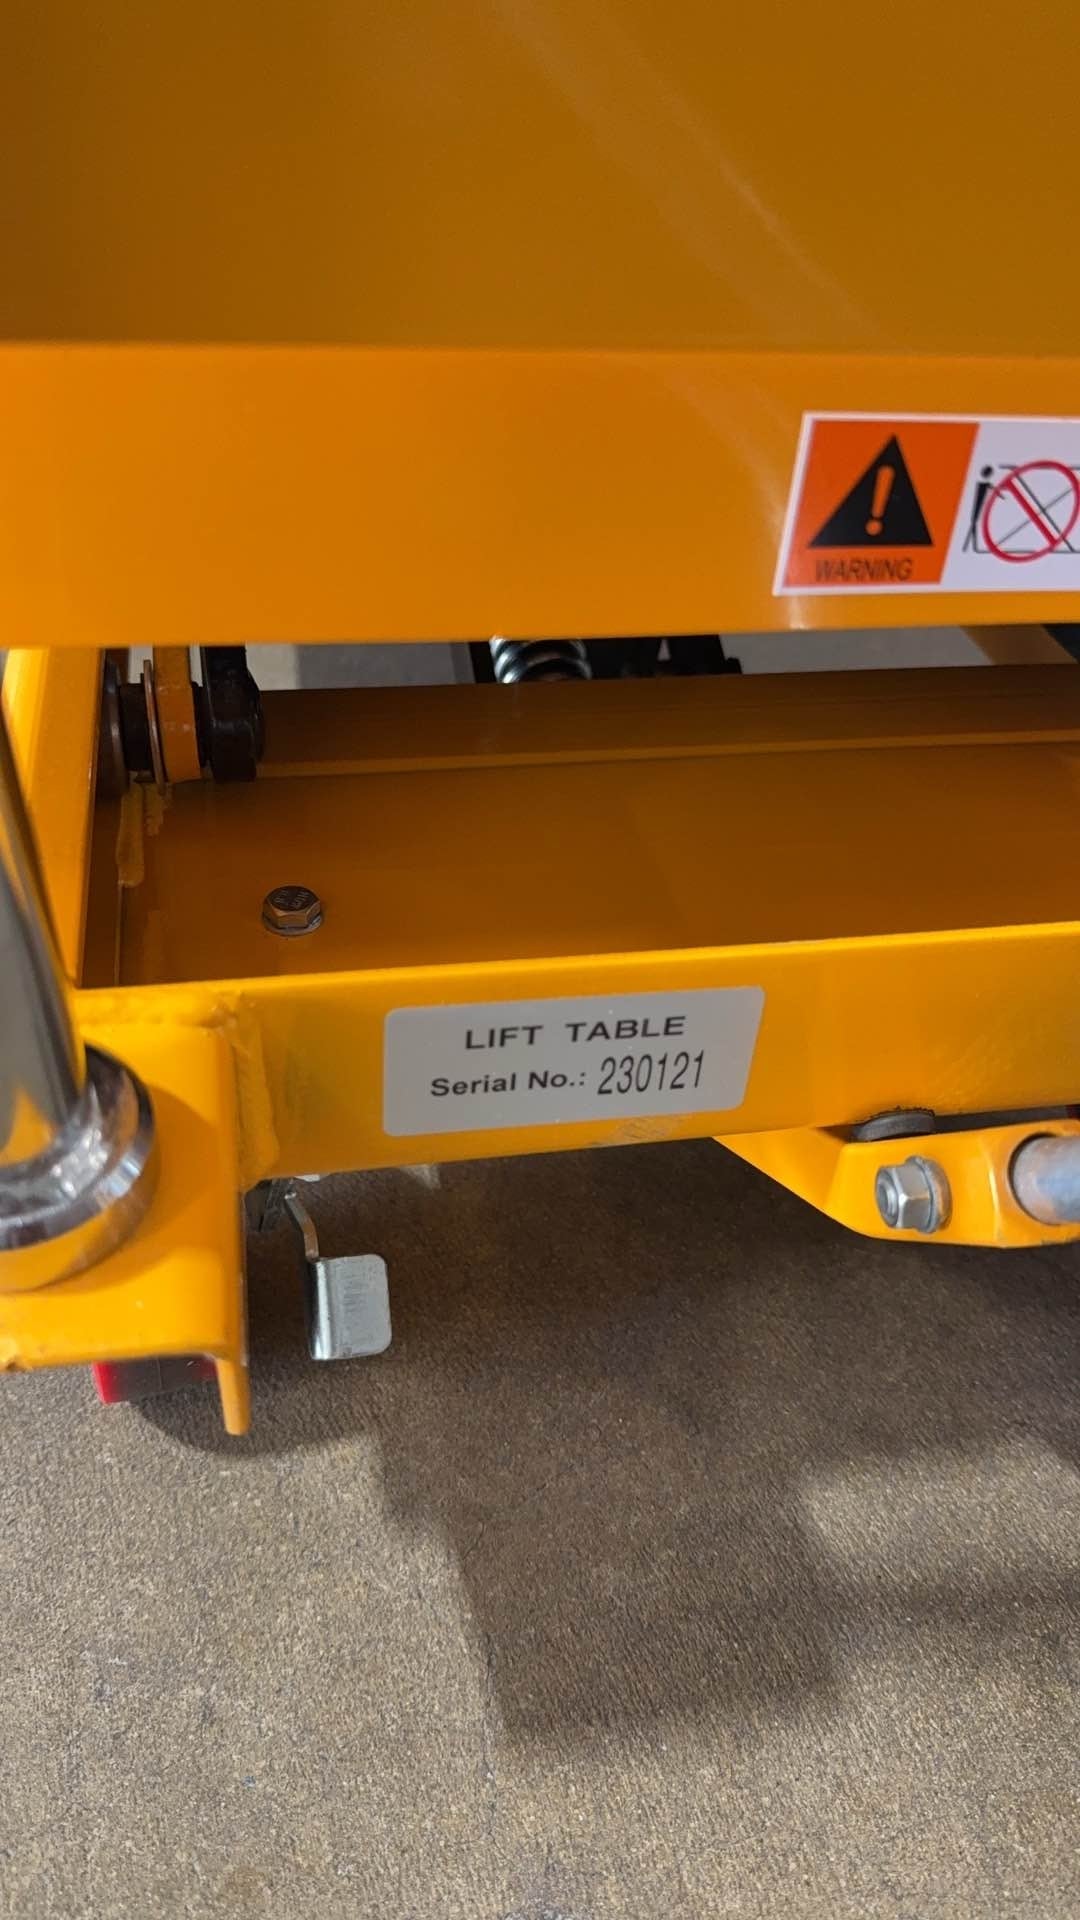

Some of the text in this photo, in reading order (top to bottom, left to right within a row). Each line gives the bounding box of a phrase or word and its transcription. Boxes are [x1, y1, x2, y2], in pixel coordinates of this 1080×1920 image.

[814, 558, 913, 581] WARNING
[465, 1016, 686, 1049] LIFT TABLE
[430, 1049, 704, 1097] Serial No.: 230121
